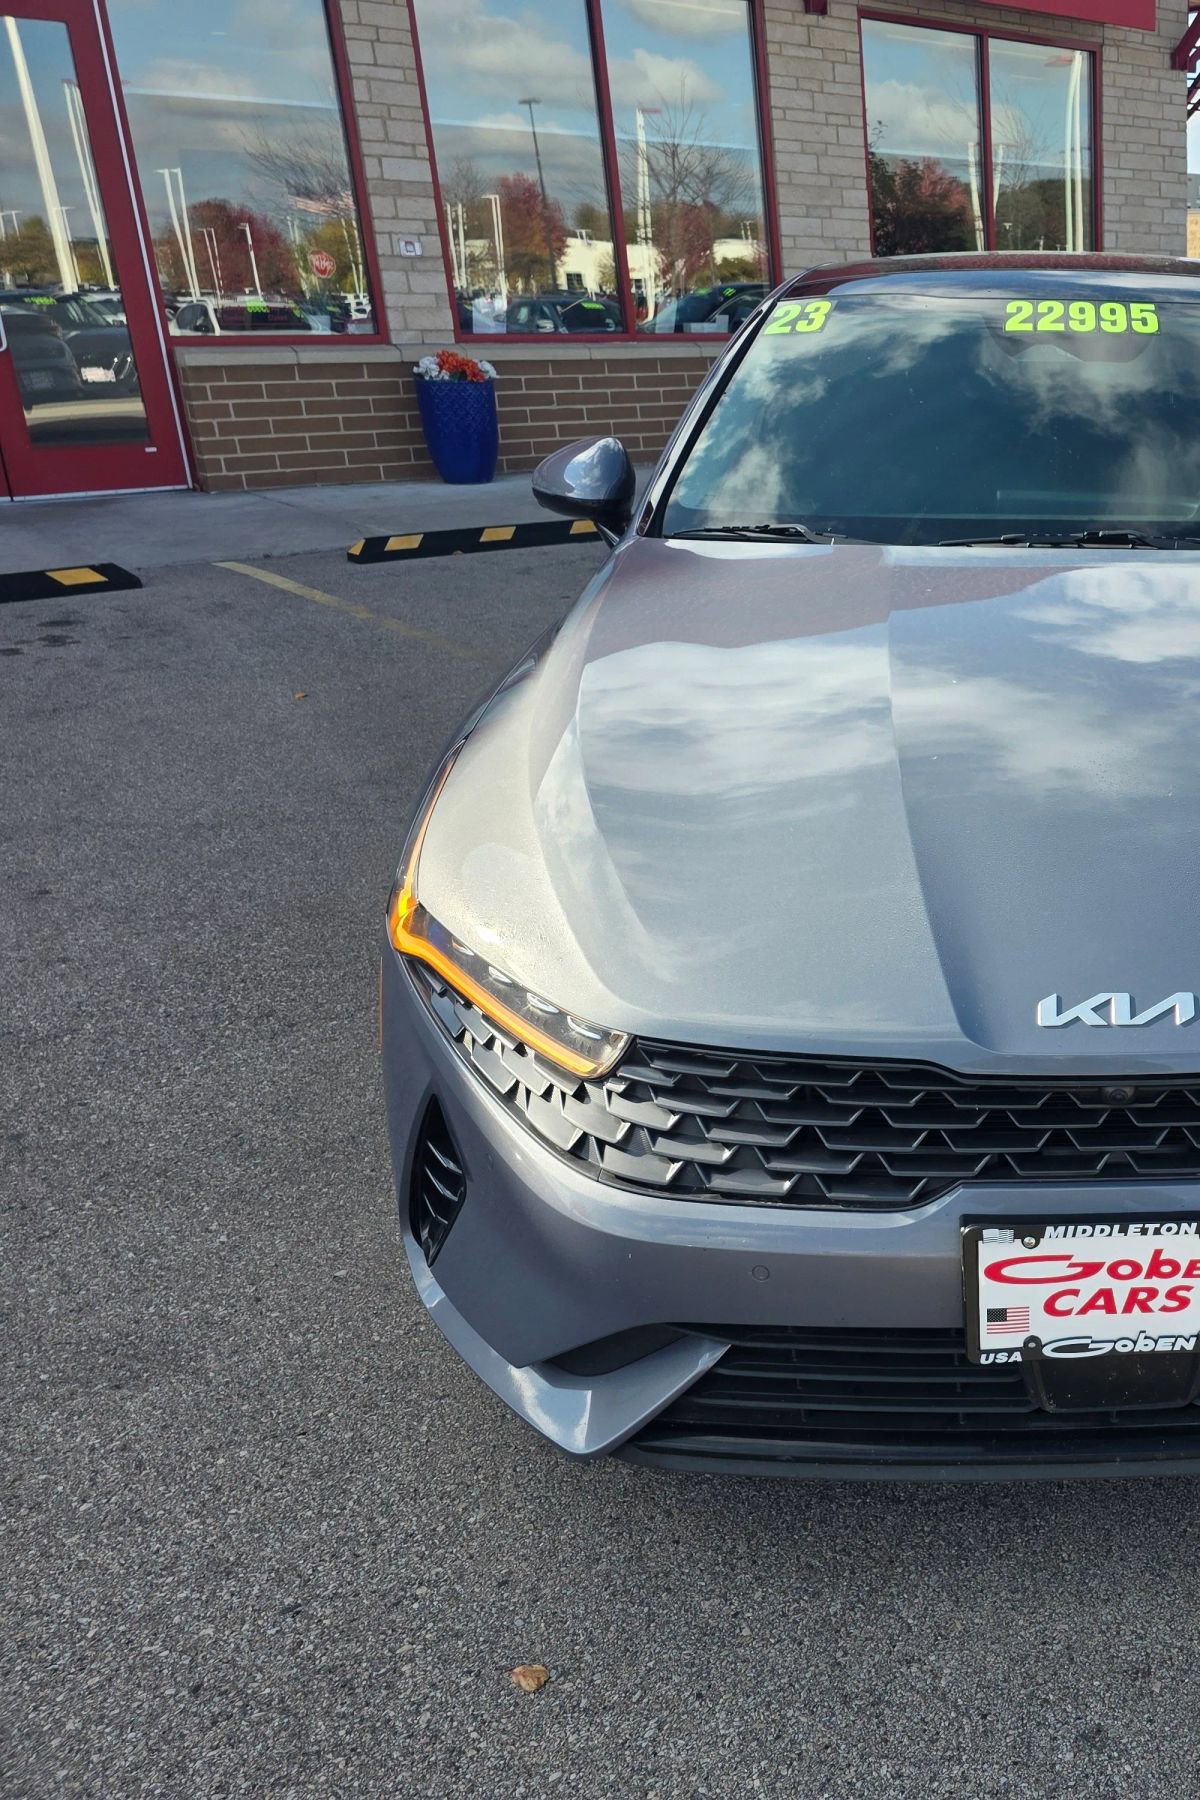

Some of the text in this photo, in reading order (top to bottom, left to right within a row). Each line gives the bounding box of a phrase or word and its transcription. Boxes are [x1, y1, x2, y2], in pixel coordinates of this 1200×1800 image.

[764, 301, 832, 335] 23
[1005, 301, 1160, 333] 22995
[1037, 992, 1196, 1026] KIA
[1044, 1222, 1198, 1240] MIDDLETON
[1043, 1285, 1195, 1317] CARS
[980, 1351, 1023, 1365] USA
